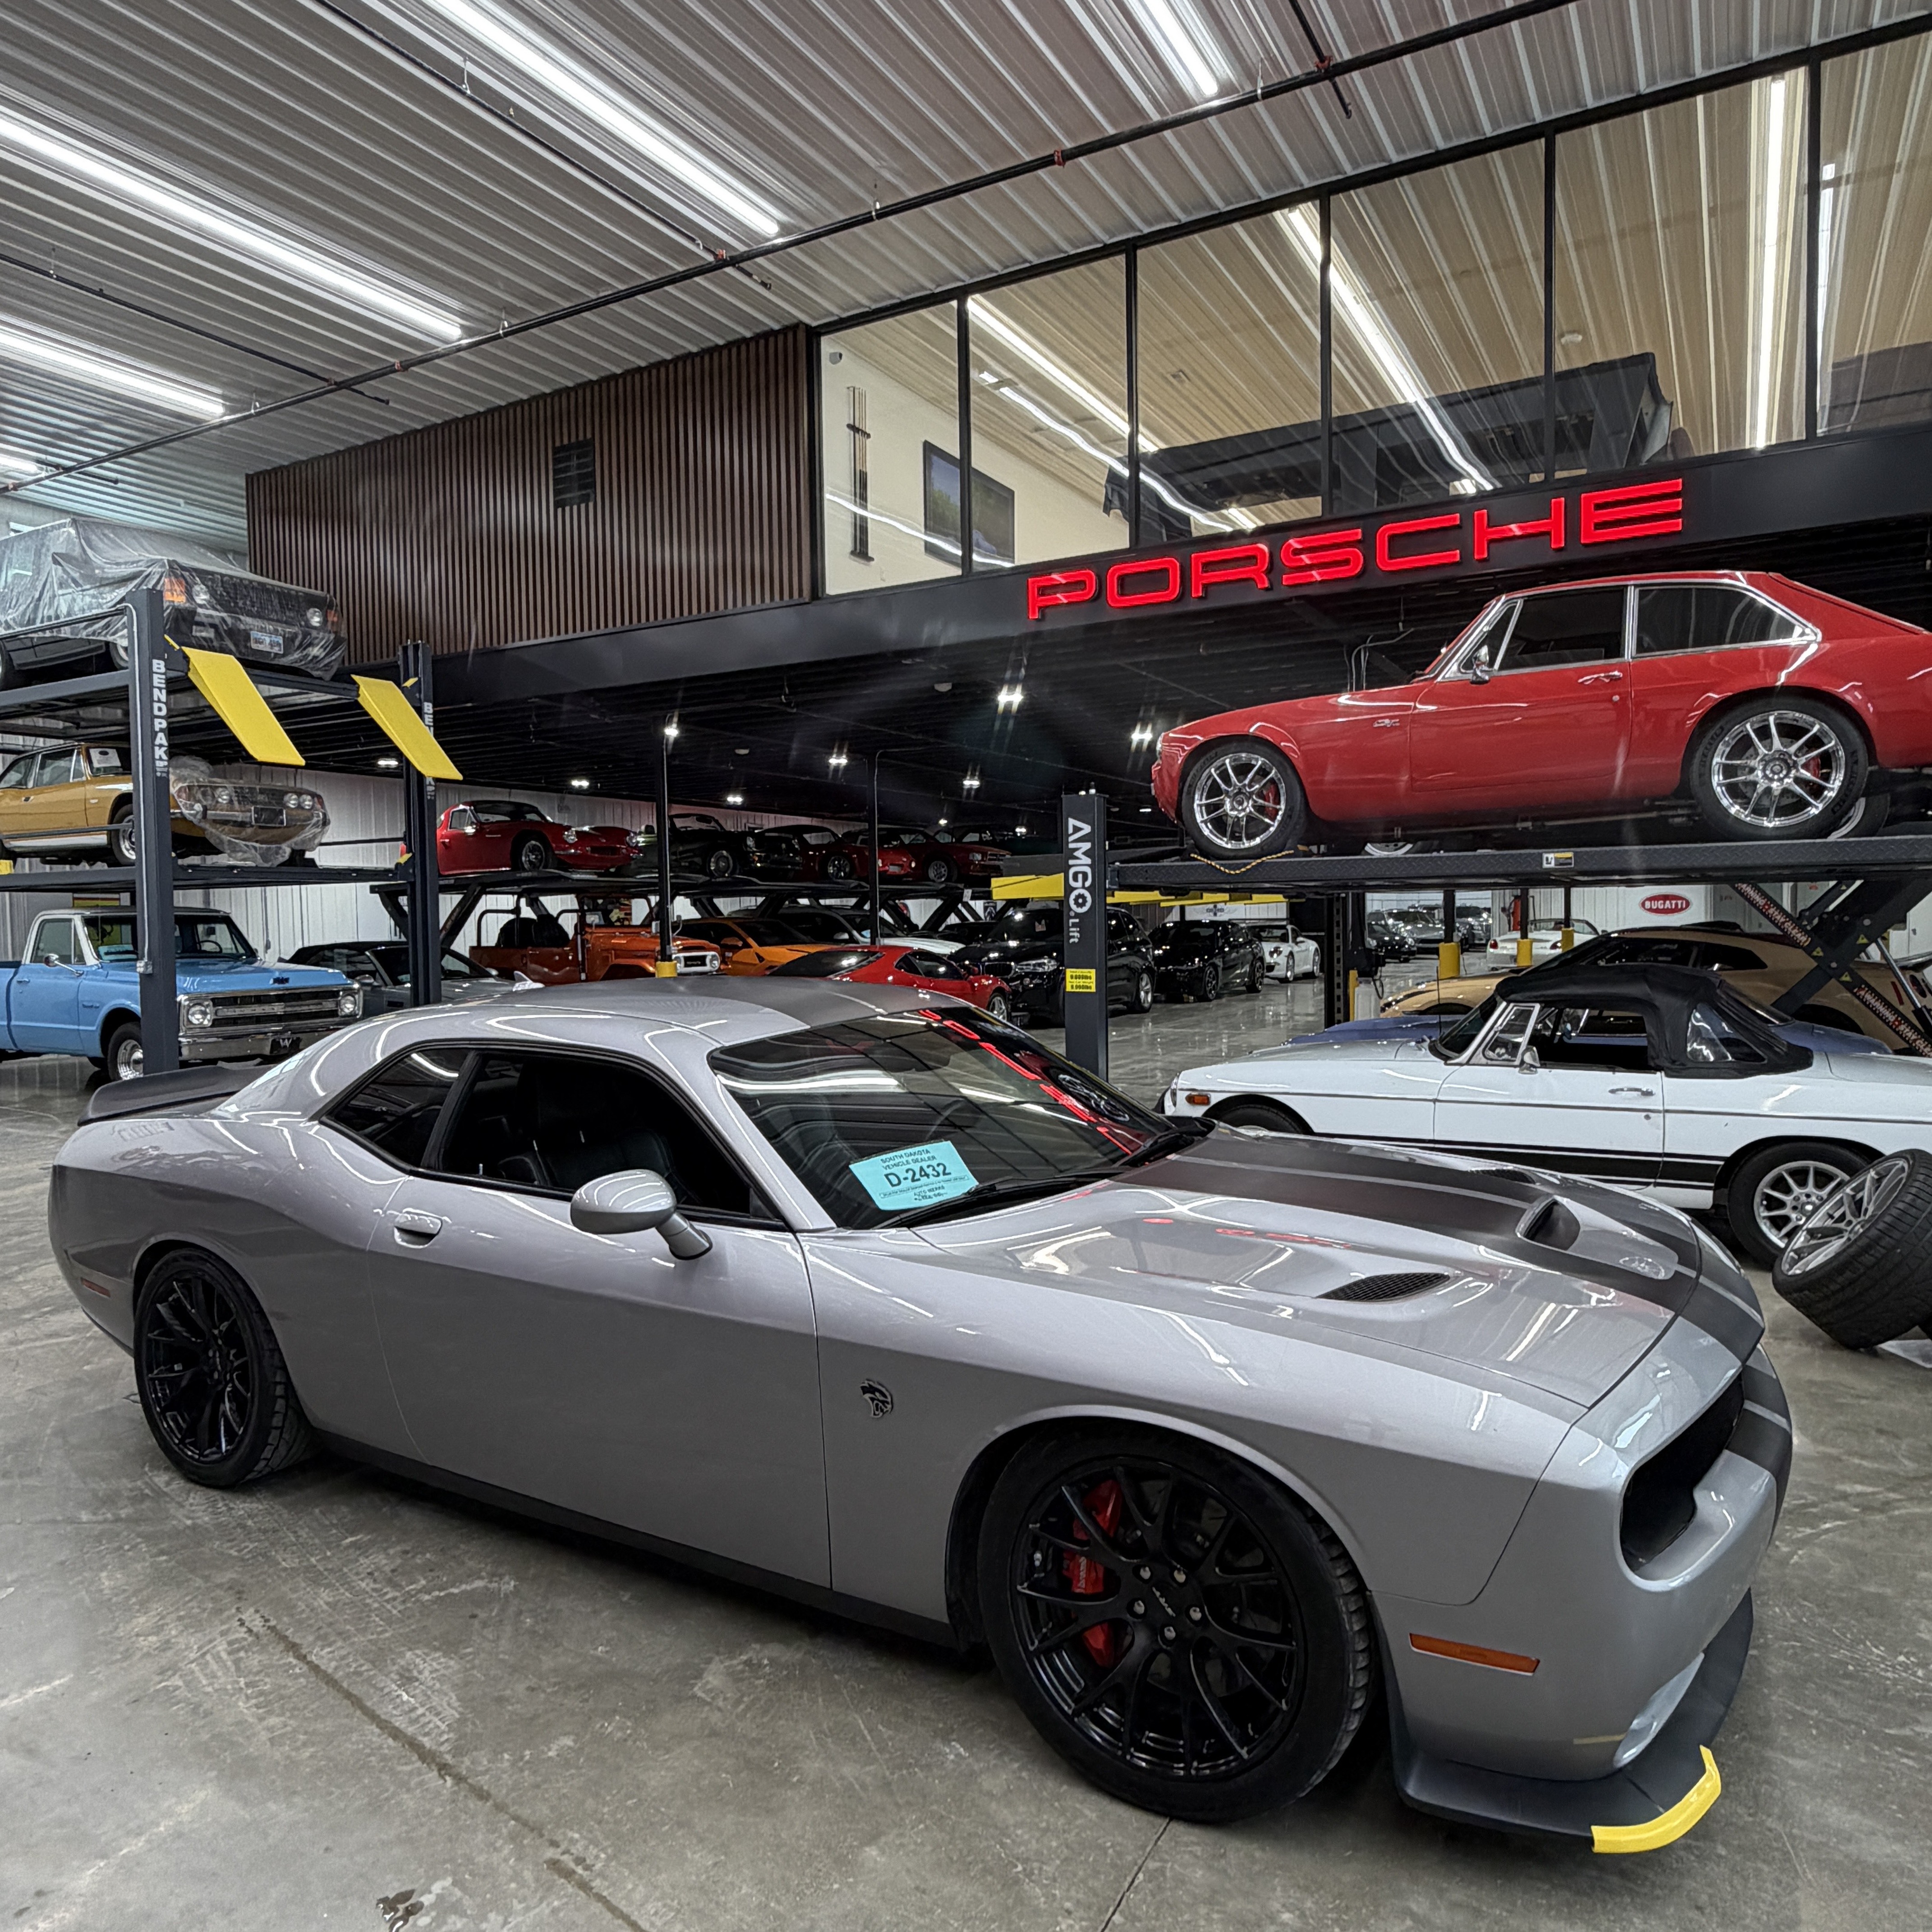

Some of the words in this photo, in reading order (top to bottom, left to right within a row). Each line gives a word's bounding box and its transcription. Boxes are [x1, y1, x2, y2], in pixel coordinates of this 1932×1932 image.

[1027, 478, 1683, 621] PORSCHE
[152, 659, 168, 760] BENDPAK
[1068, 817, 1092, 913] AMGO
[1645, 900, 1686, 909] BUGATTI
[1069, 918, 1080, 944] Lift
[1767, 906, 1786, 924] STAY
[1784, 920, 1808, 943] CLEAR
[1863, 991, 1896, 1022] WARNING
[1897, 1023, 1917, 1042] STAY
[880, 1154, 904, 1164] SOUTH
[904, 1149, 931, 1158] DAKOTA
[882, 1159, 911, 1170] VEHICLE
[911, 1155, 937, 1164] DEALER
[884, 1163, 952, 1187] D-2432
